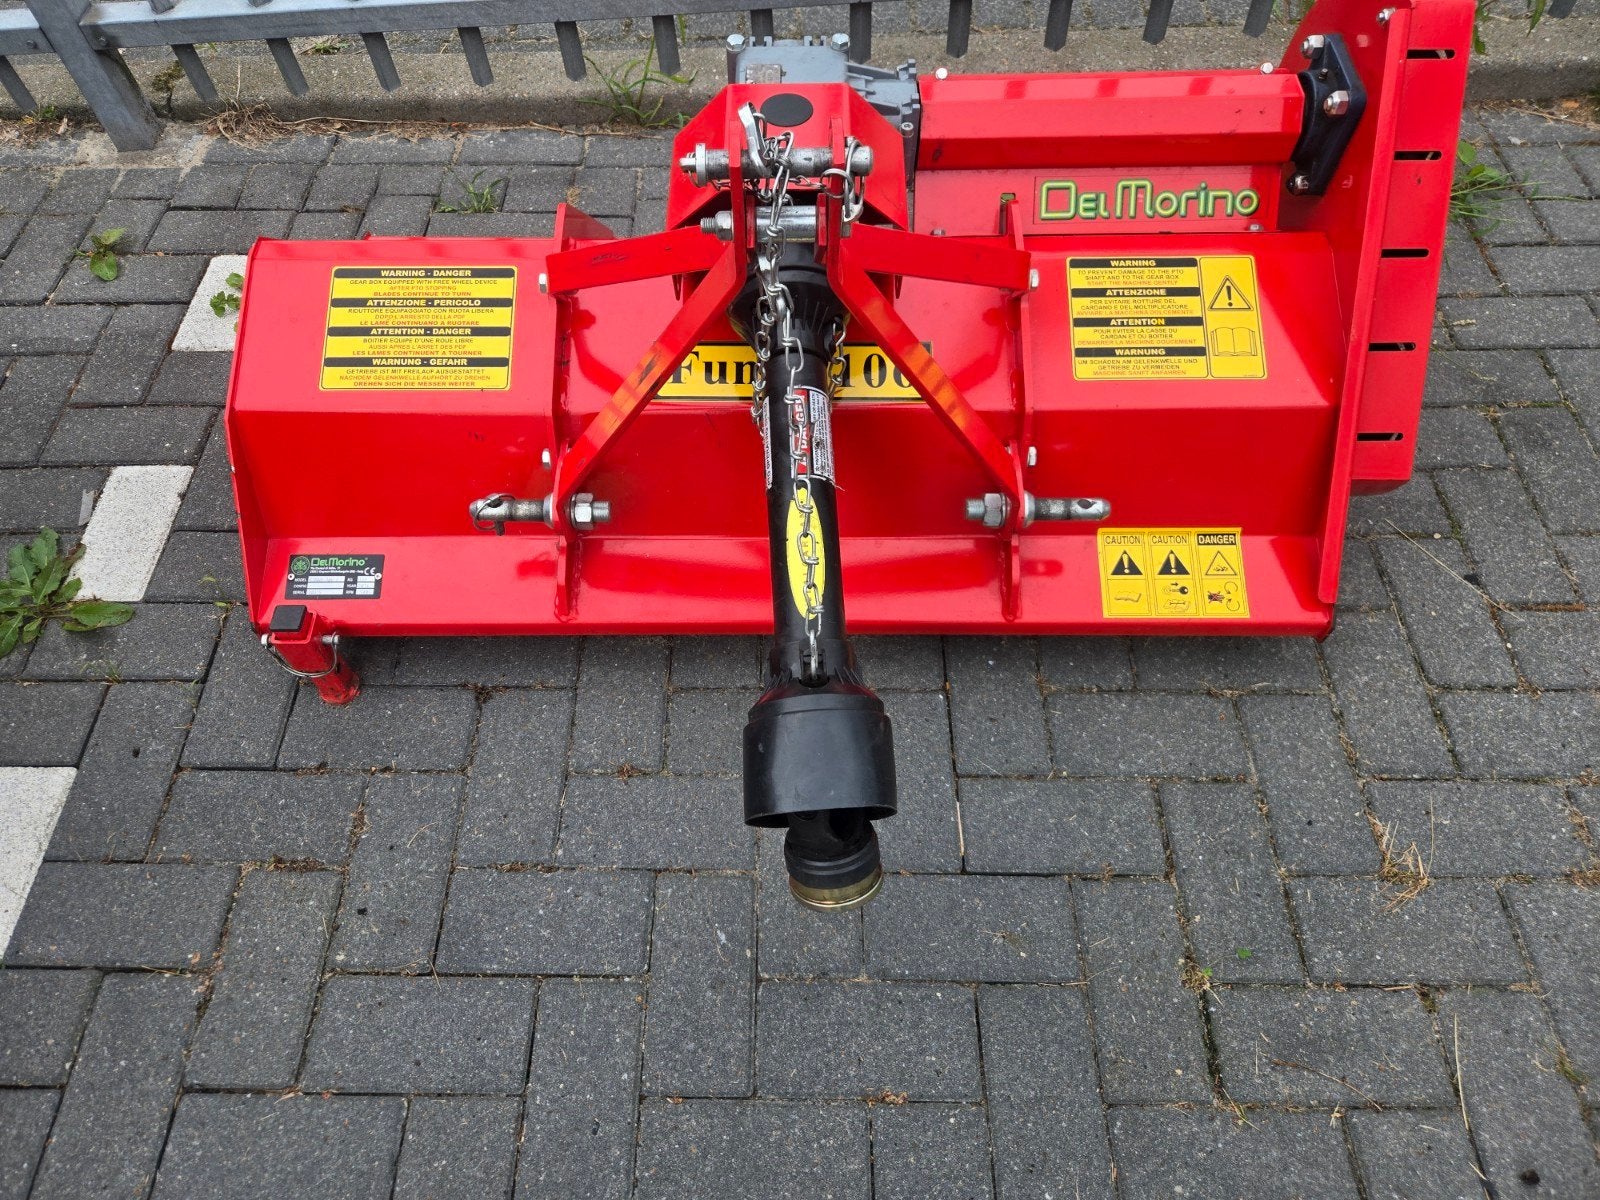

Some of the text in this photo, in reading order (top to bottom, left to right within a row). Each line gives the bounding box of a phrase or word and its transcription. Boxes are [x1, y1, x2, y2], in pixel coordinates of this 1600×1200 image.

[1105, 536, 1140, 545] CAUTION
[1152, 535, 1187, 544] CAUTION
[1198, 535, 1235, 544] DANGER
